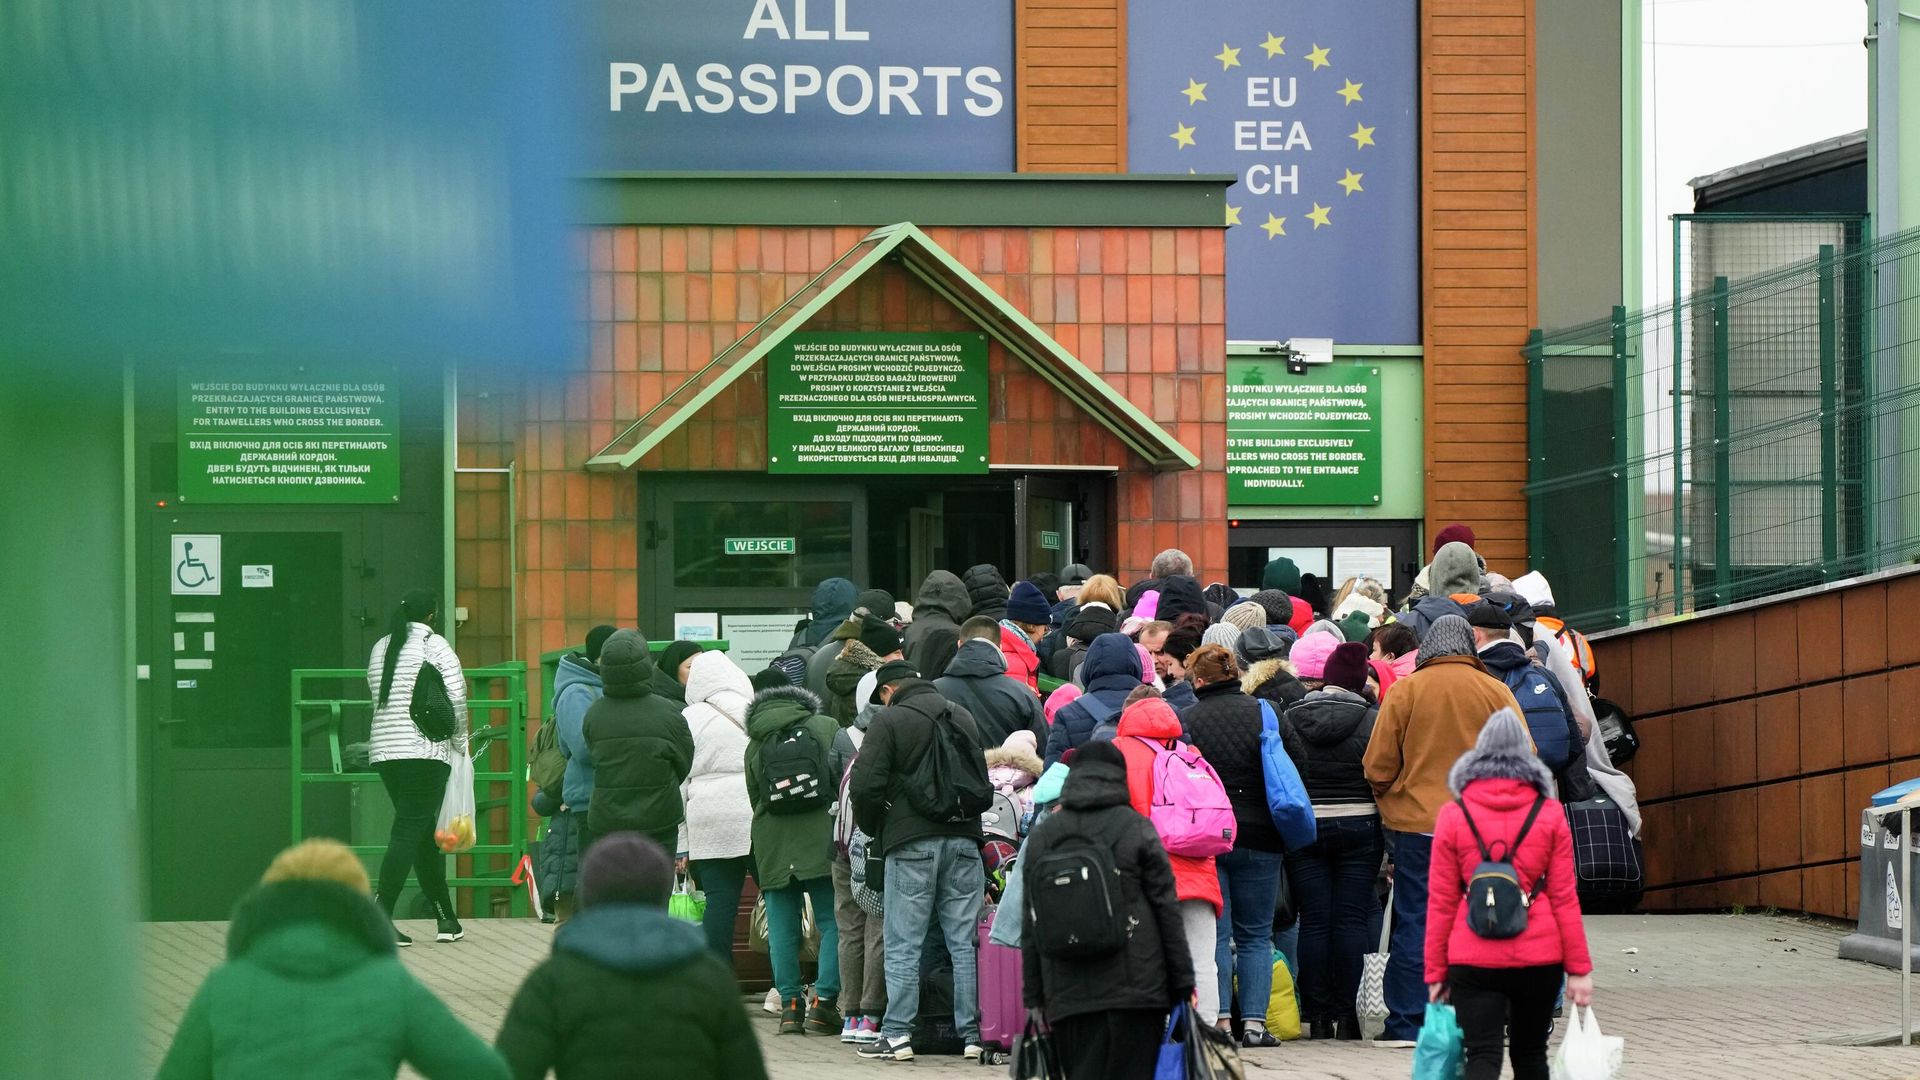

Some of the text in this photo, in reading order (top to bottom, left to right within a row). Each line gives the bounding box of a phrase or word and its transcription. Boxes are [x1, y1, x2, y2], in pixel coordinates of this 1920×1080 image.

[743, 0, 869, 40] ALL
[610, 63, 1003, 116] PASSPORTS
[1248, 78, 1296, 107] EU
[1235, 121, 1312, 150] EEA
[1246, 165, 1298, 194] CH
[794, 344, 827, 352] WEJŚCIE
[878, 345, 923, 353] WYŁĄCZNIE
[941, 344, 961, 352] OSÓB
[795, 353, 961, 363] PRZEKRACZAJĄCYCH GRANICĘ PAŃSTWOWĄ.
[802, 363, 836, 371] WEJŚCIA
[872, 363, 912, 371] WCHODZIĆ
[854, 374, 884, 382] DUŻEGO
[886, 374, 916, 382] BAGAŻU
[918, 375, 956, 383] (ROWERU)
[191, 383, 229, 391] WEJŚCIE
[245, 384, 287, 392] BUDYNKU
[289, 384, 340, 392] WYŁĄCZNIE
[342, 384, 360, 392] DLA
[361, 384, 384, 392] OSÓB
[911, 384, 945, 392] WEJŚCIA
[1232, 385, 1273, 393] BUDYNKU
[1274, 385, 1324, 394] WYŁĄCZNIE
[1325, 385, 1342, 393] DLA
[1344, 384, 1367, 393] OSÓB
[192, 394, 384, 404] PRZEKRACZAJĄCYCH GRANICĘ PAŃSTWOWĄ.
[866, 393, 887, 401] OSÓB
[1269, 399, 1307, 407] GRANICĘ
[1308, 398, 1366, 408] PAŃSTWOWĄ.
[250, 407, 267, 415] THE
[269, 407, 311, 415] BUILDING
[313, 407, 370, 415] EXCLUSIVELY
[1229, 411, 1371, 420] PROSIMY WCHODZIĆ POJEDYNCZO.
[194, 418, 210, 426] FOR
[212, 418, 271, 426] TRAWELLERS
[326, 419, 343, 427] THE
[345, 419, 383, 427] BORDER.
[793, 415, 811, 423] ВХІД
[854, 415, 871, 423] ДЛЯ
[836, 424, 920, 433] ДЕРЖАВНИЙ КОРДОН.
[813, 435, 824, 443] ДО
[825, 435, 850, 443] ВХОДУ
[852, 435, 896, 443] ПІДХОДИТИ
[910, 435, 943, 443] ОДНОМУ.
[1236, 439, 1253, 447] THE
[1255, 439, 1295, 447] BUILDING
[190, 442, 387, 450] ВХІД ВІКЛЮЧНО ДЛЯ ОСІБ ЯКІ ПЕРЕТИНАЮТЬ
[798, 445, 835, 453] ВИПАДКУ
[912, 445, 964, 453] (ВЕЛОСИПЕД)
[240, 452, 337, 462] ДЕРЖАВНИЙ КОРДОН.
[878, 455, 897, 463] ВХІД
[899, 455, 916, 463] ДЛЯ
[917, 455, 959, 463] ІНВАЛІДІВ.
[1259, 453, 1279, 461] WHO
[1280, 453, 1308, 461] CROSS
[1310, 453, 1326, 461] THE
[1328, 453, 1365, 461] BORDER.
[207, 465, 370, 473] ДВЕРІ БУДУТЬ ВІДЧИНЕНІ, ЯК ТІЛЬКИ
[213, 477, 365, 485] НАТИСНЕТЬСЯ КНОПКУ ДЗВОНИКА.
[1245, 480, 1304, 488] INDIVIDUALLY.
[733, 540, 787, 551] WEJŚCIE
